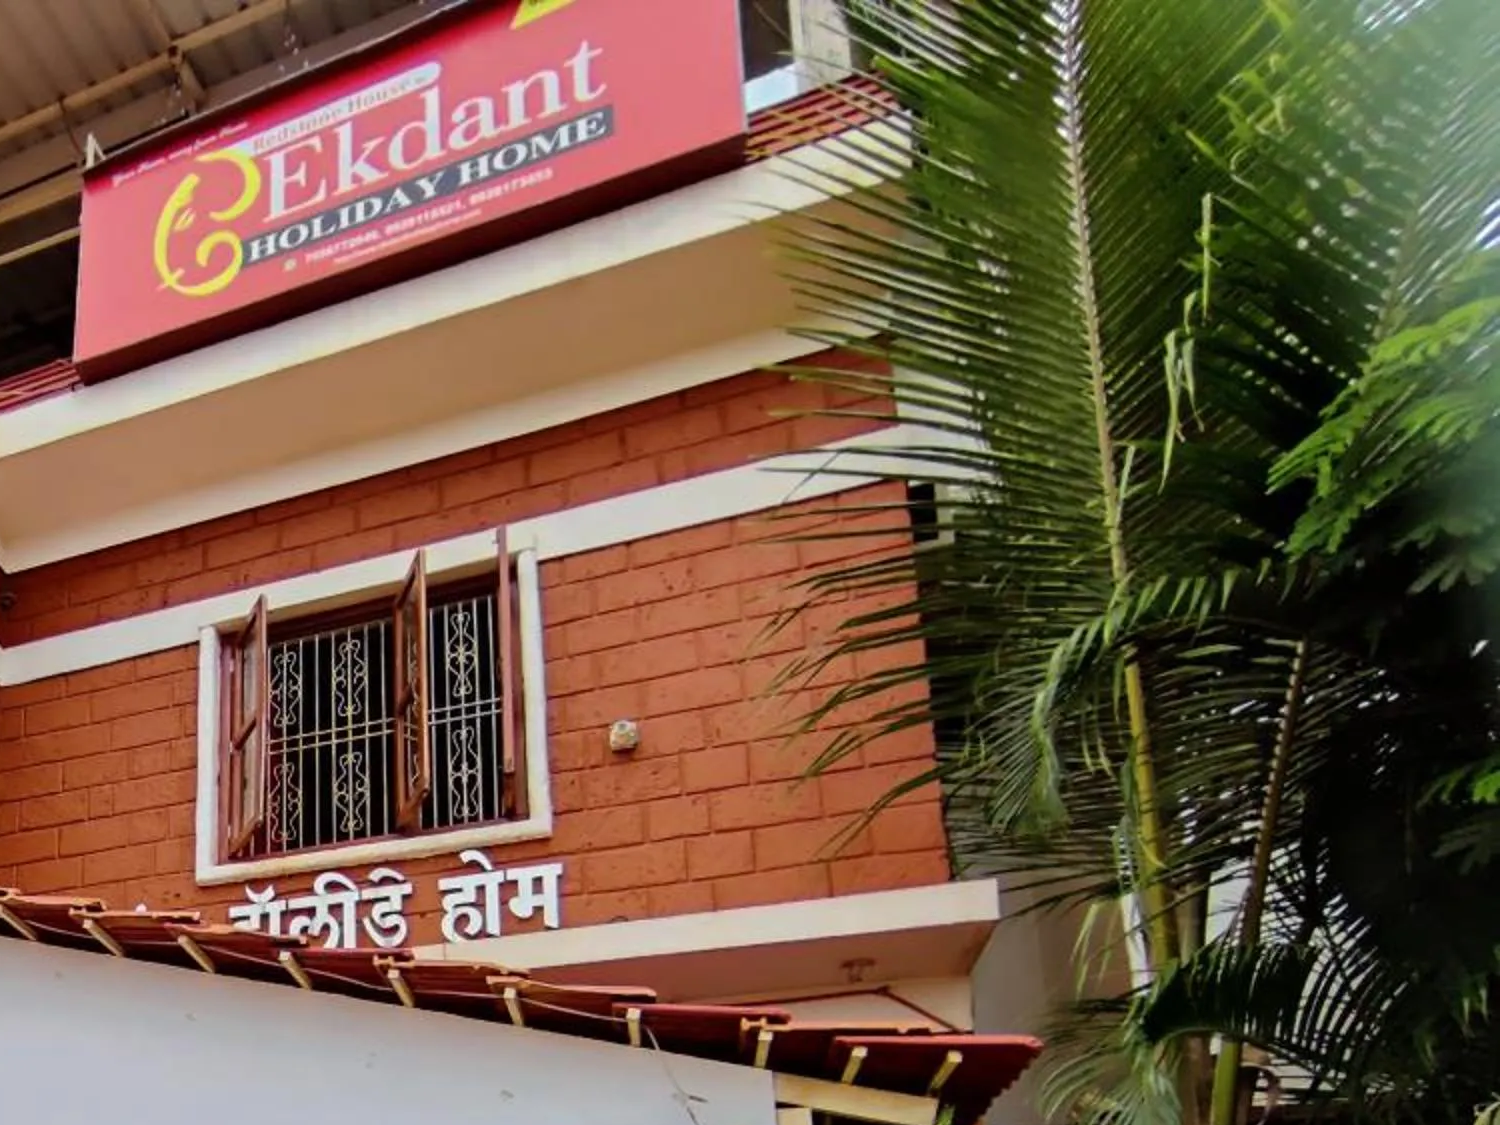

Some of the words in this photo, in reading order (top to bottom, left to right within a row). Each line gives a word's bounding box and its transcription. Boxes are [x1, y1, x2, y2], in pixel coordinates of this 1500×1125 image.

[249, 171, 446, 262] HOLIDAY
[457, 111, 606, 185] HOME
[260, 39, 607, 222] Ekdant
[438, 850, 562, 943] होम
